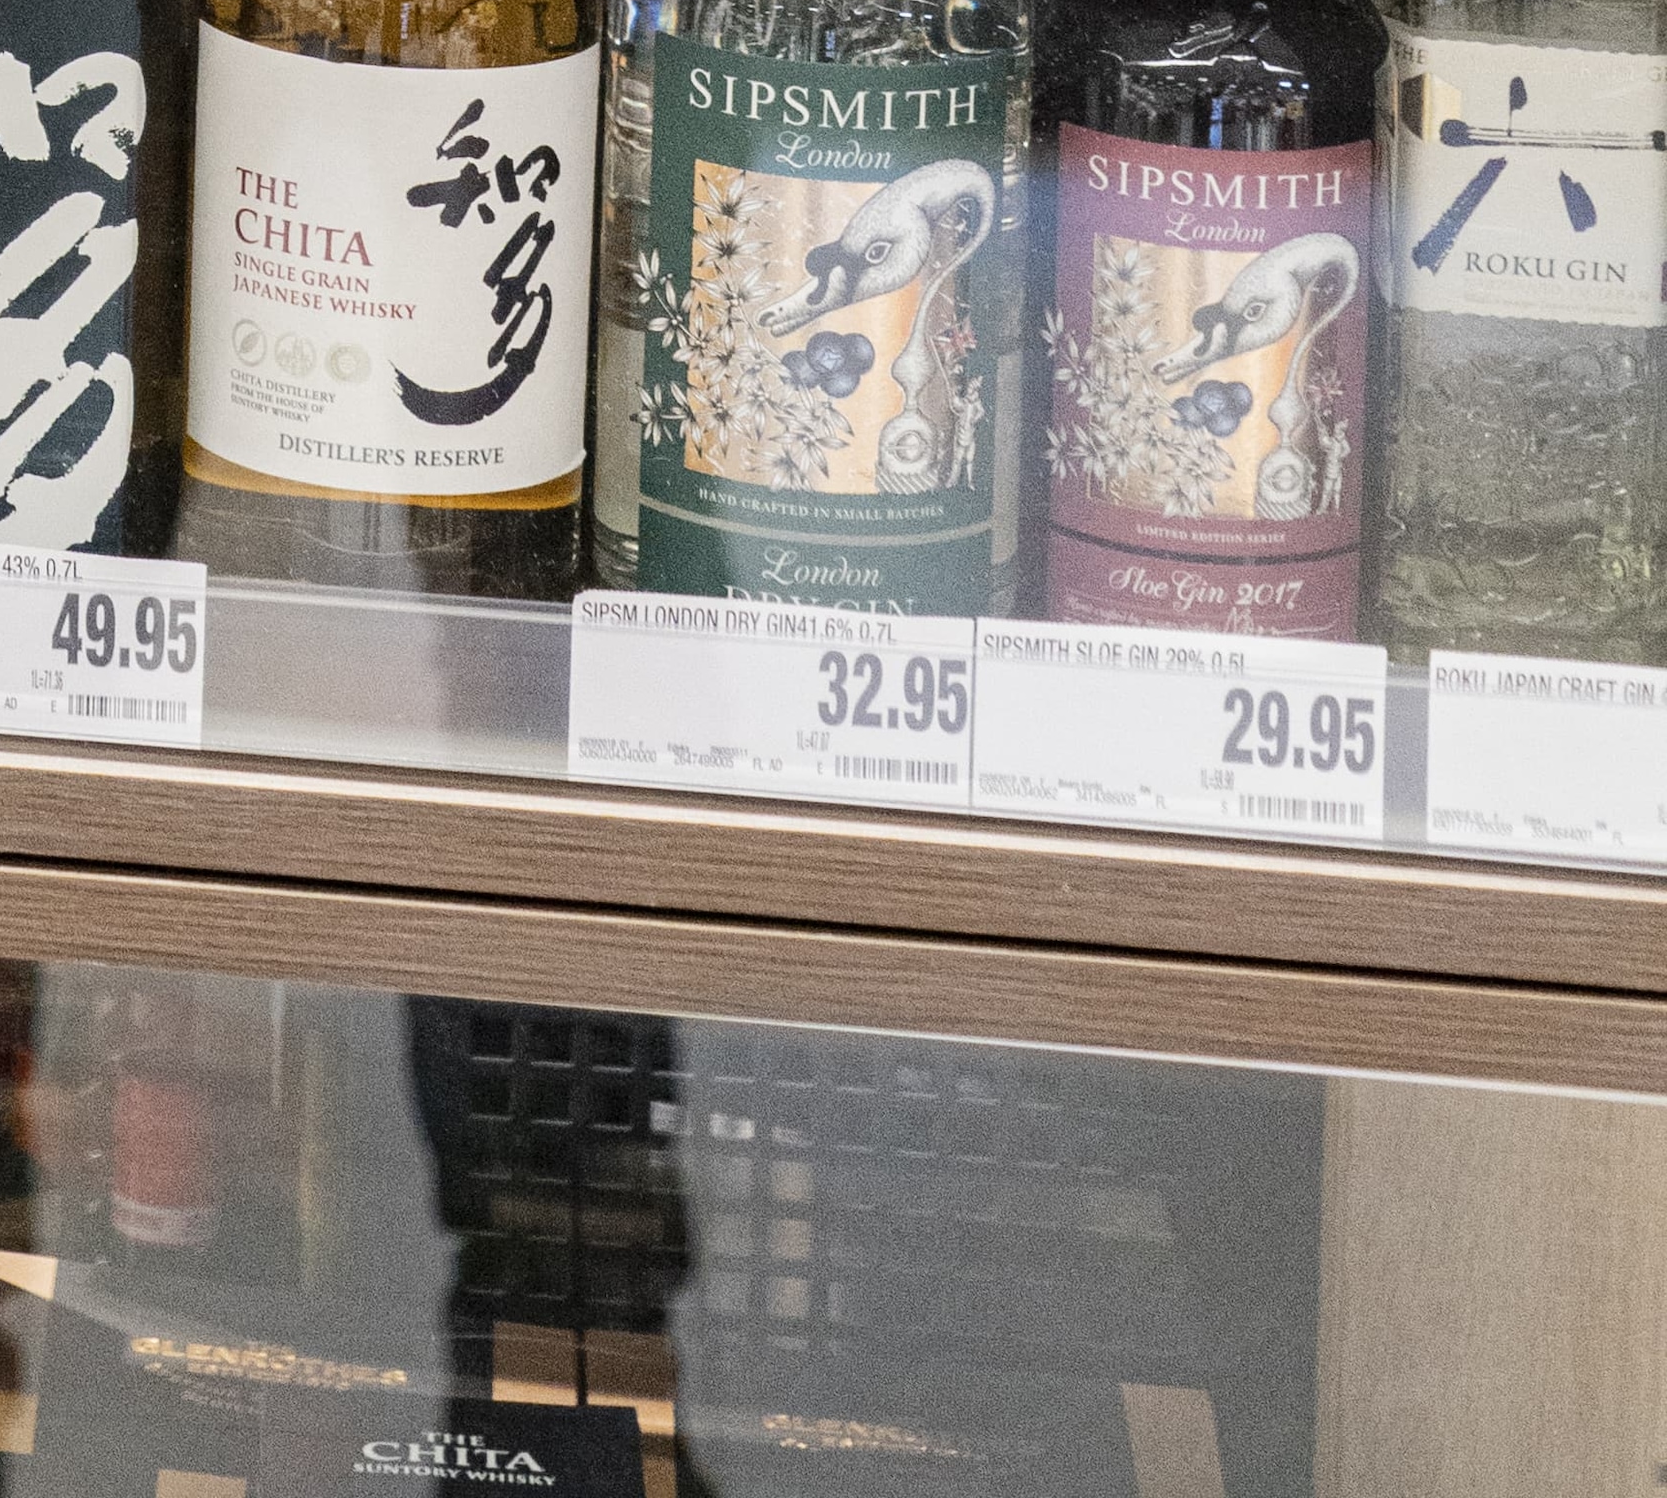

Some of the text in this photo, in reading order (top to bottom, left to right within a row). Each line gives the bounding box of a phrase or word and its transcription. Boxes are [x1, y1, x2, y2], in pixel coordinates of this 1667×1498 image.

[689, 68, 979, 131] SIPSMITH
[776, 131, 891, 171] London
[236, 166, 299, 209] THE
[1088, 154, 1342, 209] SIPSMITH
[235, 209, 374, 268] CHITA
[1165, 212, 1265, 244] London
[1466, 252, 1627, 283] ROKU GIN
[1109, 566, 1303, 607] Sloe Gin 2017
[52, 593, 197, 673] 49.95
[818, 650, 967, 733] 32.95
[1222, 688, 1375, 774] 29.95
[362, 1441, 545, 1472] CHITA
